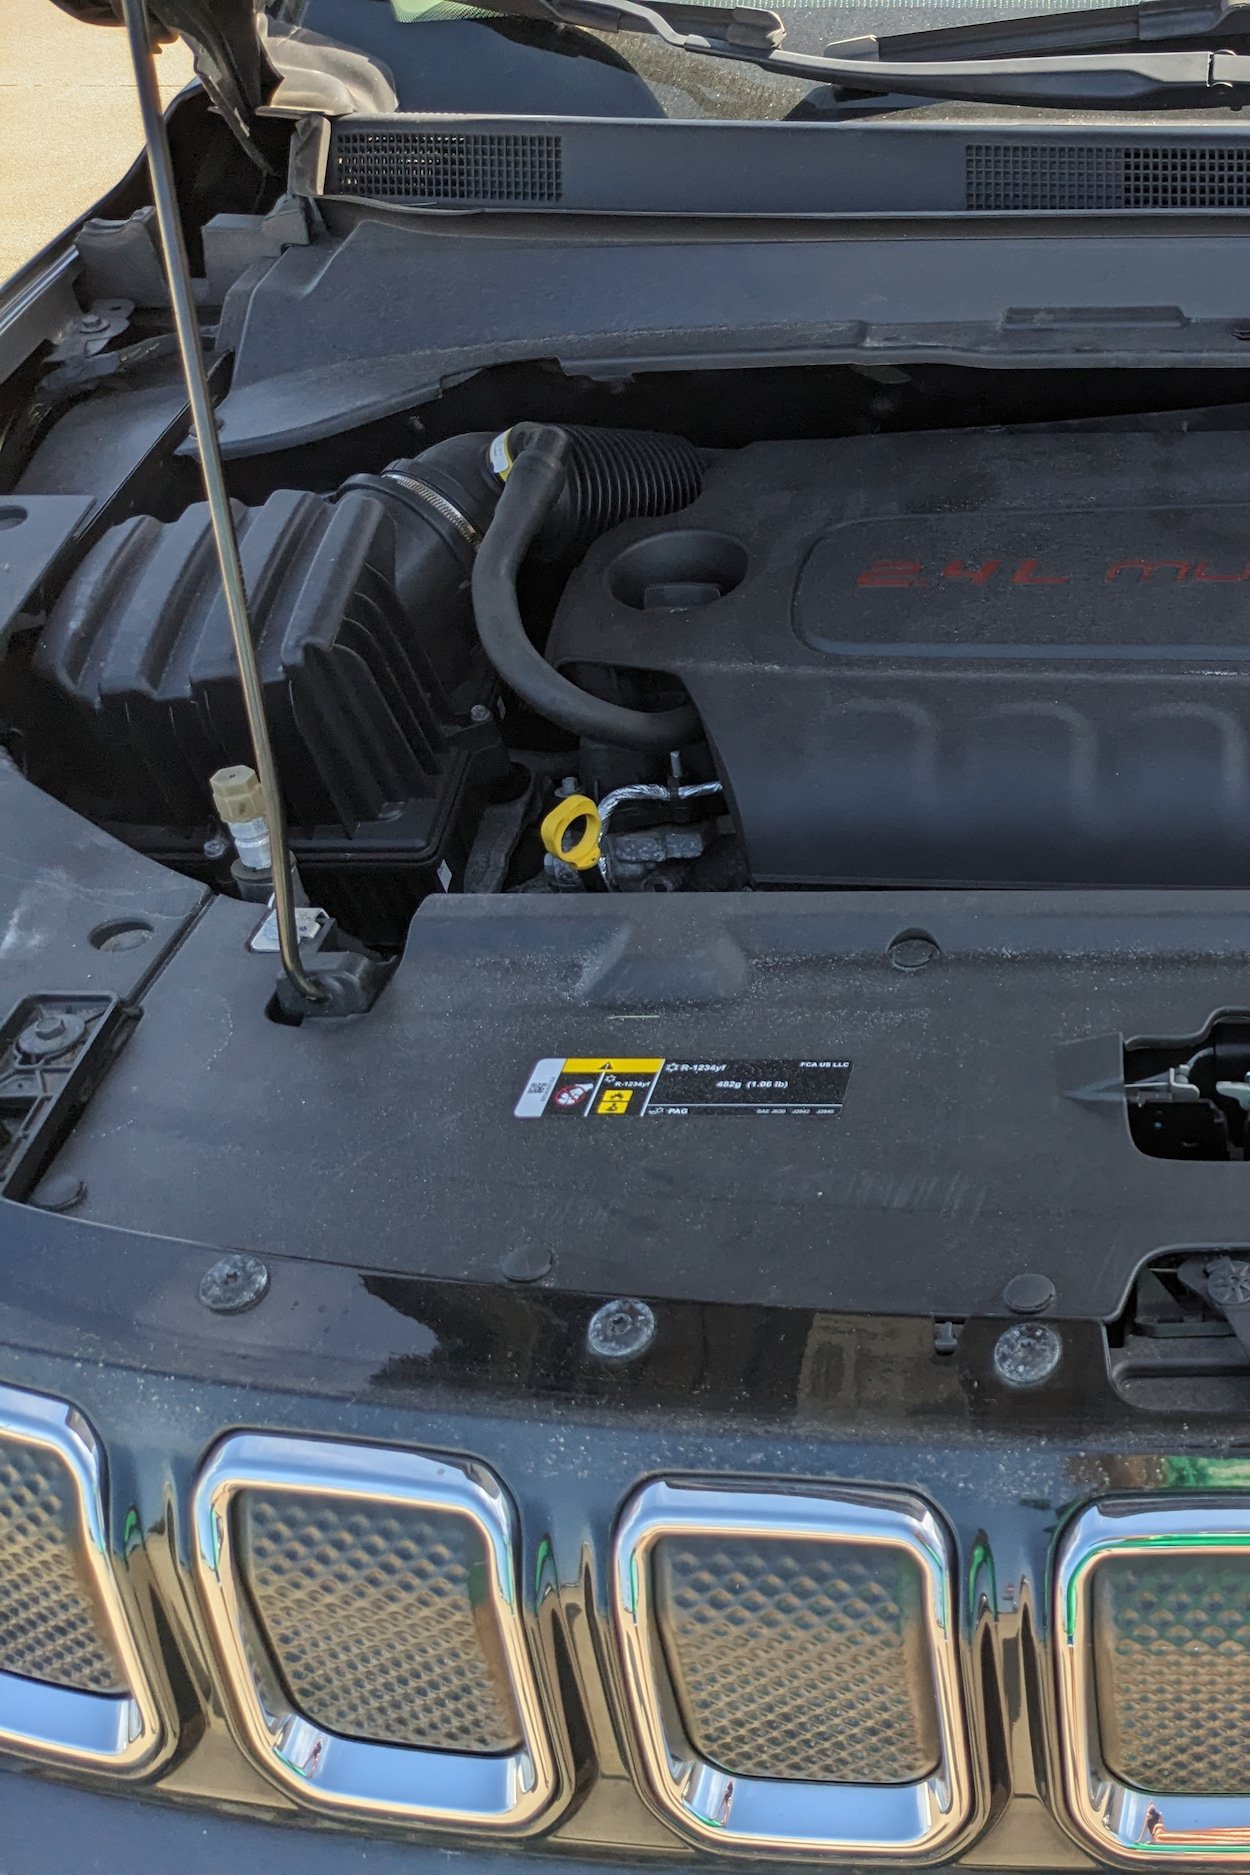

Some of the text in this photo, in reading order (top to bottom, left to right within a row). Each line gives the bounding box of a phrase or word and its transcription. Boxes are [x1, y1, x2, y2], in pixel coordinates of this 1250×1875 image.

[680, 1064, 726, 1073] R-1234yf
[716, 1080, 742, 1089] 482g
[746, 1080, 773, 1089] (1.06
